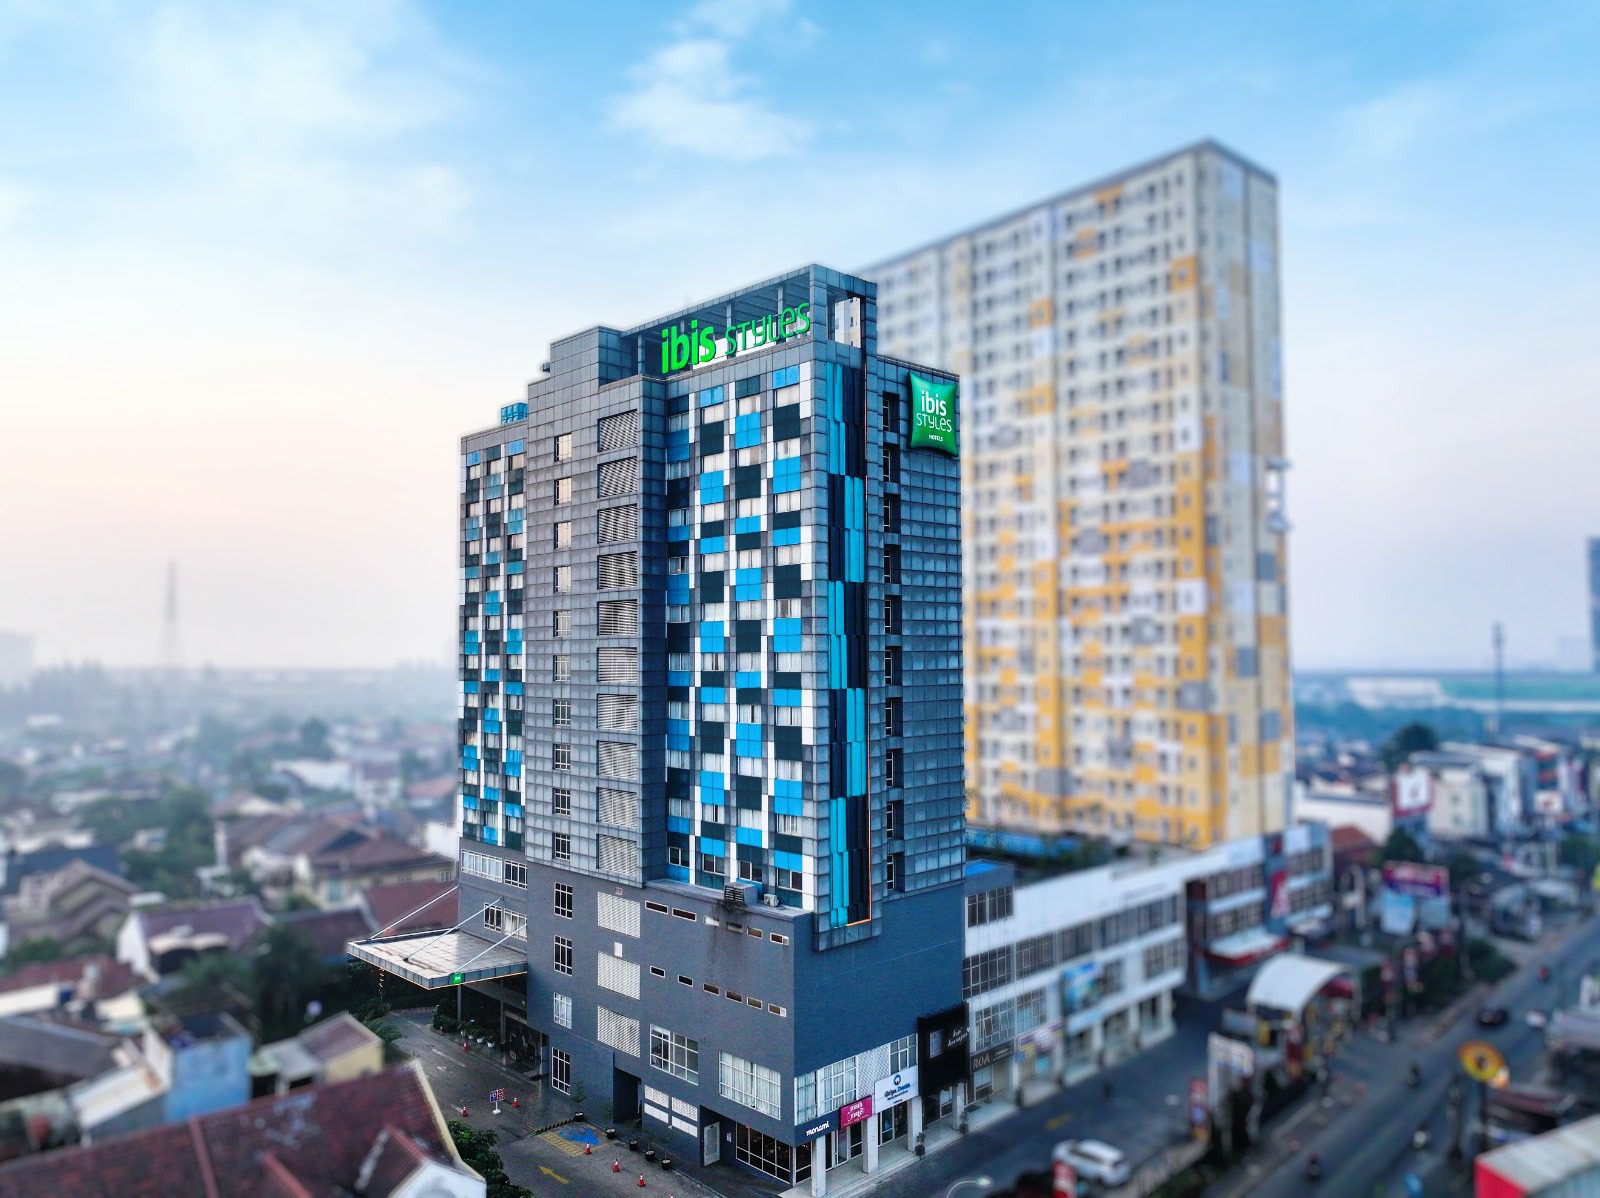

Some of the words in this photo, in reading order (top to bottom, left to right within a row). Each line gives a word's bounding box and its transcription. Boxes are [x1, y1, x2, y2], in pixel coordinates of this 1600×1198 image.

[661, 320, 717, 374] ibis
[921, 390, 947, 417] ibis
[929, 434, 944, 442] HOTELS
